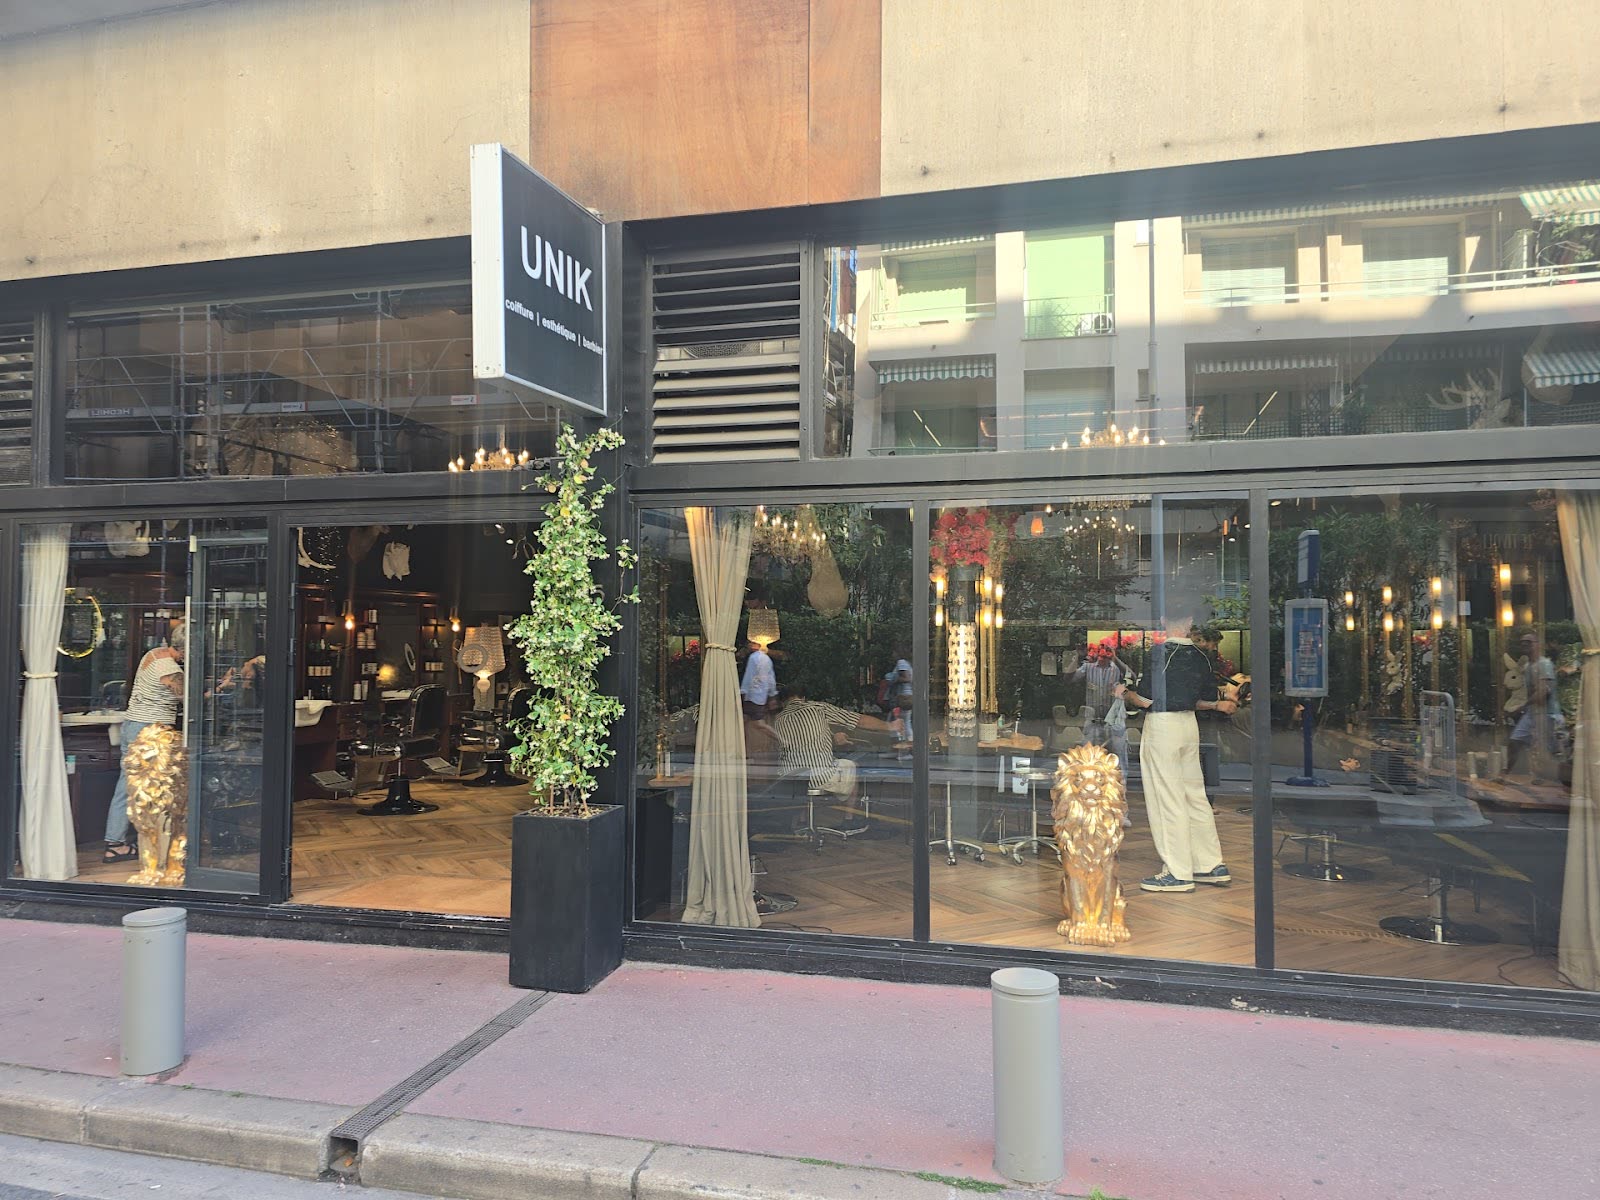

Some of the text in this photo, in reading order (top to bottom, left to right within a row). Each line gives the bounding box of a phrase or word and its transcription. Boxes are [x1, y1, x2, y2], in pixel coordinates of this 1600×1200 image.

[520, 225, 593, 312] UNIK
[505, 298, 534, 321] coiffure
[542, 317, 577, 342] esthétique
